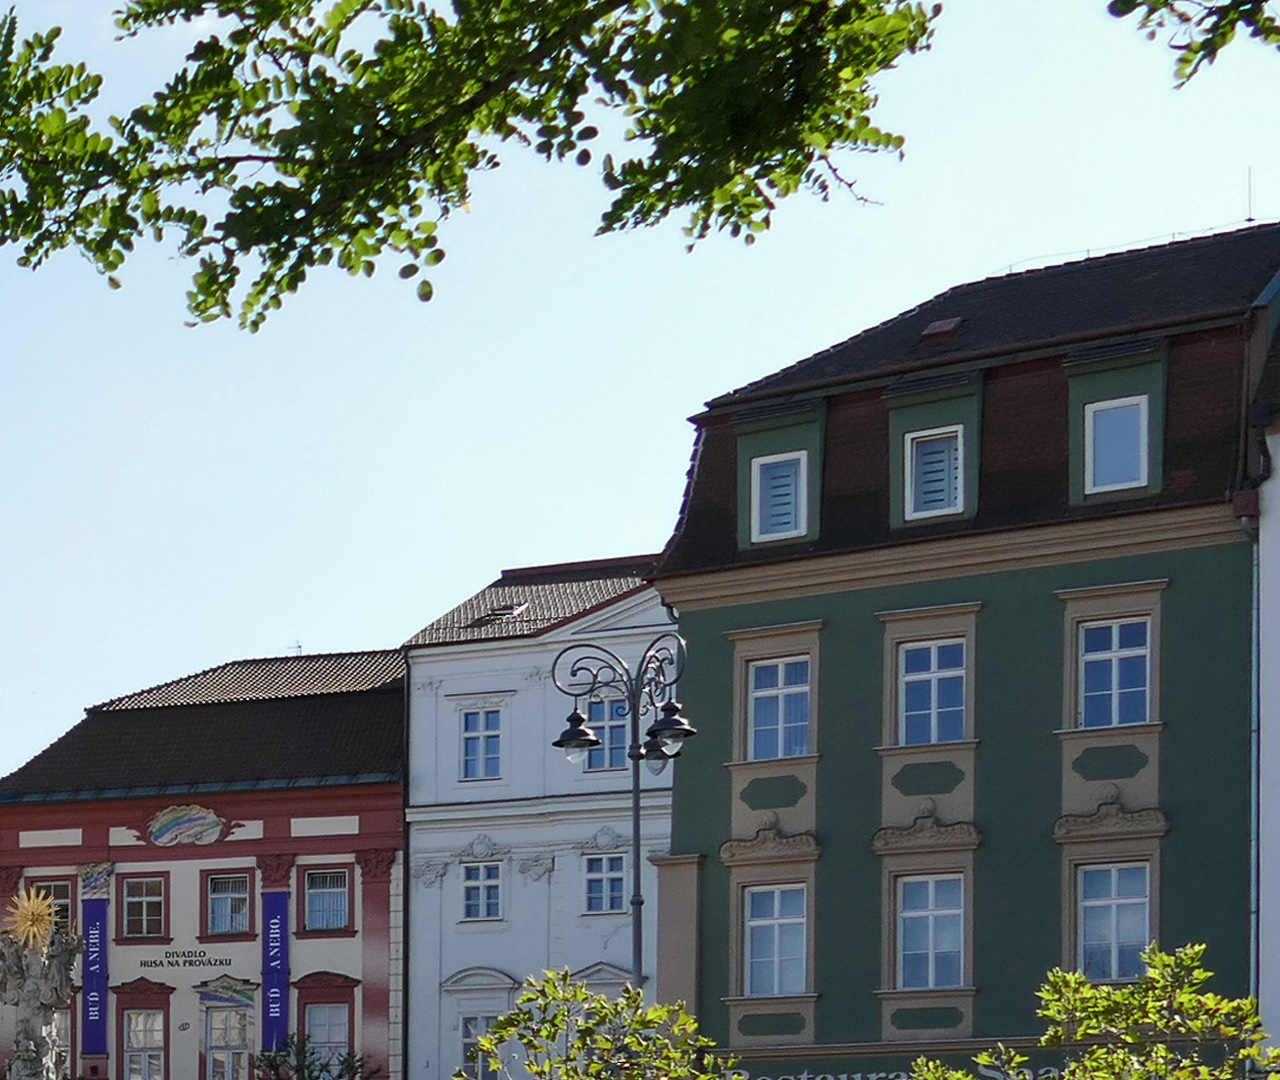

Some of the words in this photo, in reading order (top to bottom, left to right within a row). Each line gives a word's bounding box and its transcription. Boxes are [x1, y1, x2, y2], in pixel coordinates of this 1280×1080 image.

[164, 950, 206, 959] DIVADLO
[140, 959, 164, 968] HUSA
[167, 959, 180, 967] NA
[183, 957, 232, 967] PROVÁZKU
